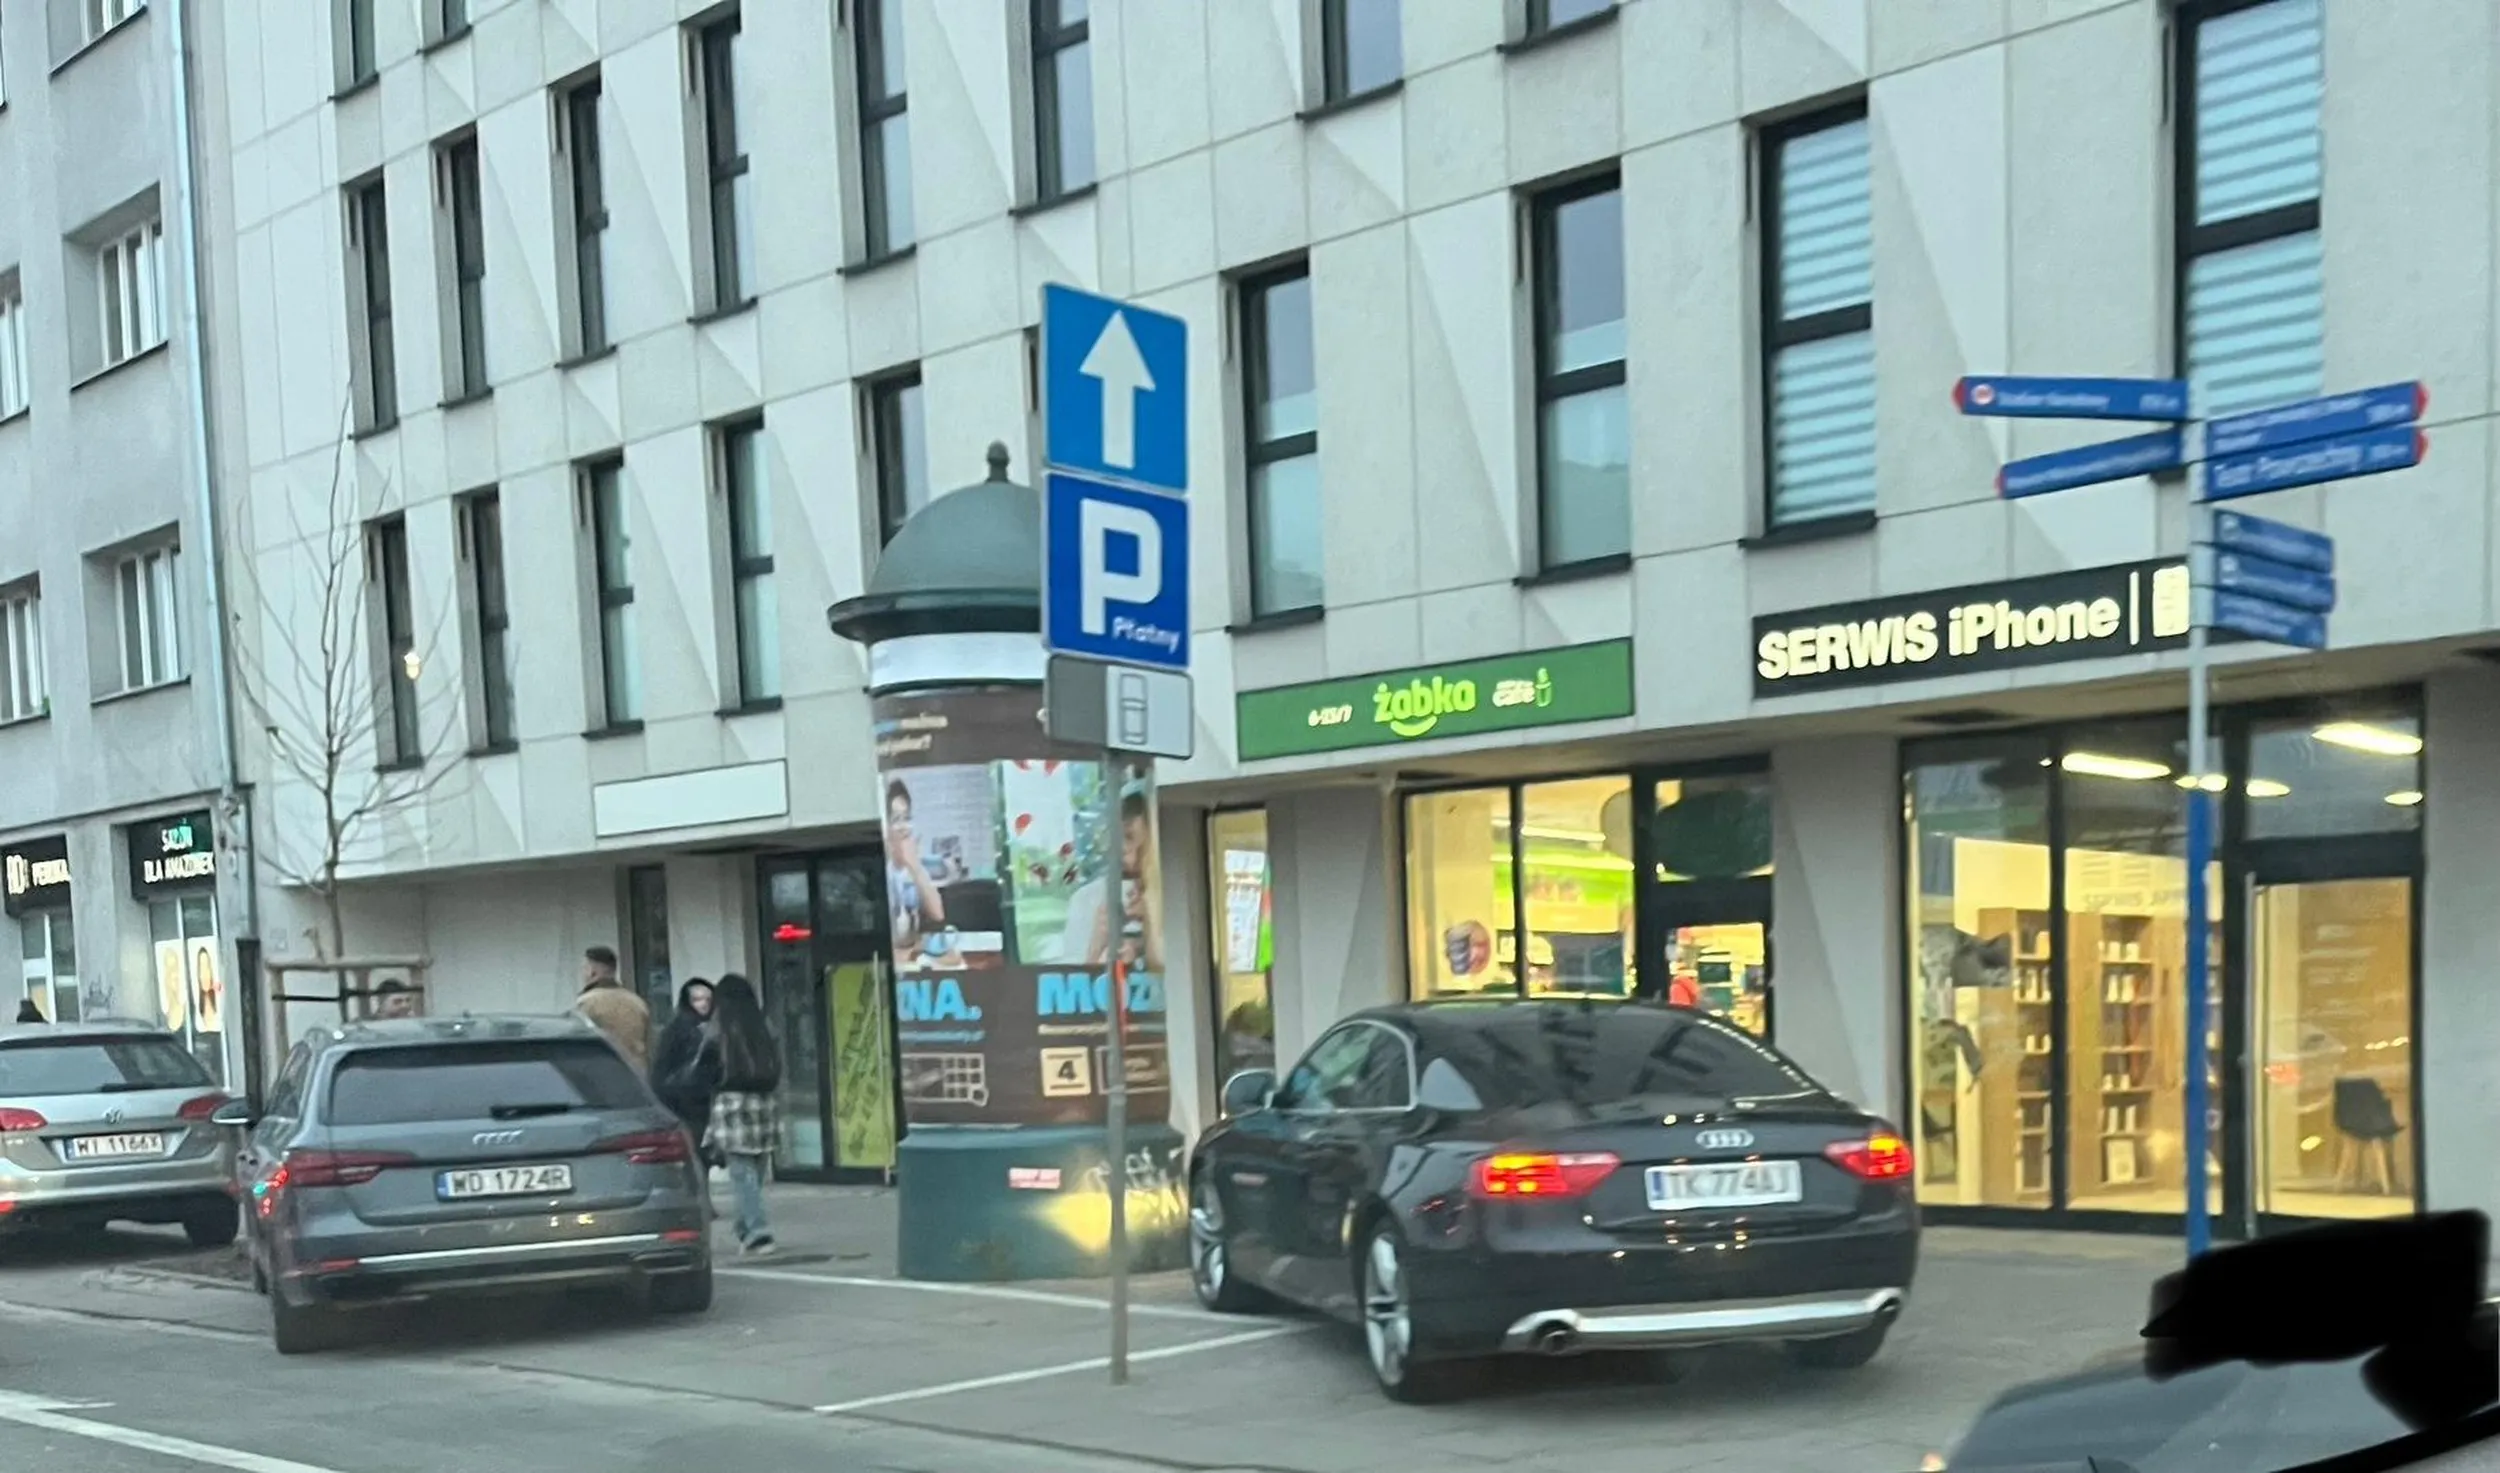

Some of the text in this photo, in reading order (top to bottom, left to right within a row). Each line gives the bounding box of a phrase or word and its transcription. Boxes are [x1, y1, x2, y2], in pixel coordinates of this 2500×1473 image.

[1081, 497, 1162, 635] P
[1757, 597, 2120, 680] SERWIS iPhone
[1373, 675, 1476, 722] żabka
[1057, 1060, 1077, 1081] 4
